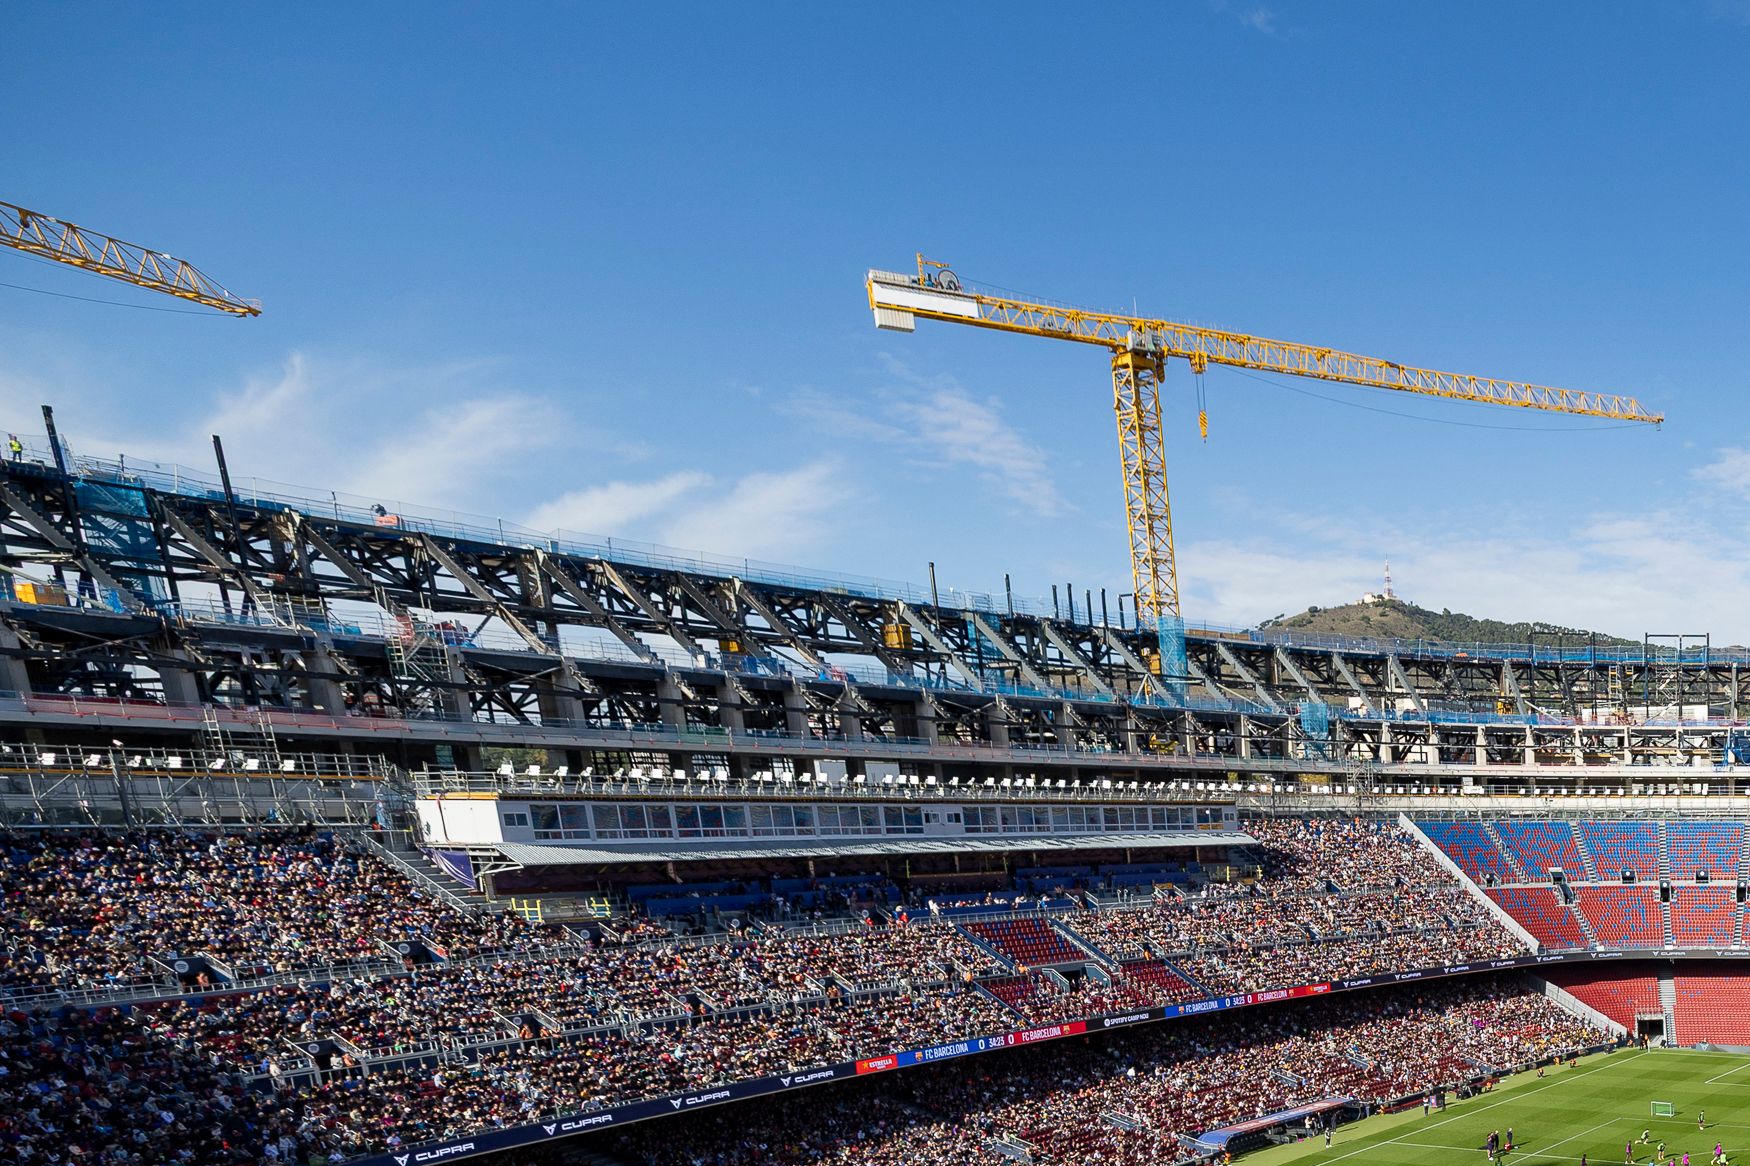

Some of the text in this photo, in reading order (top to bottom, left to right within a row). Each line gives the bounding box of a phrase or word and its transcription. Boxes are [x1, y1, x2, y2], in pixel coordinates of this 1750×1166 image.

[1192, 1000, 1218, 1012] BARCELONA
[1264, 989, 1287, 1000] BARCELONA
[1110, 1012, 1149, 1026] SPOTIFY CAMP NOU
[925, 1025, 1062, 1059] FC BARCELONA 0 34:23 0 FC BARCELONA
[794, 1070, 834, 1083] CUPRA
[686, 1090, 730, 1105] CUPRA
[561, 1114, 613, 1131] CUPRA
[415, 1142, 475, 1161] CUPRA
